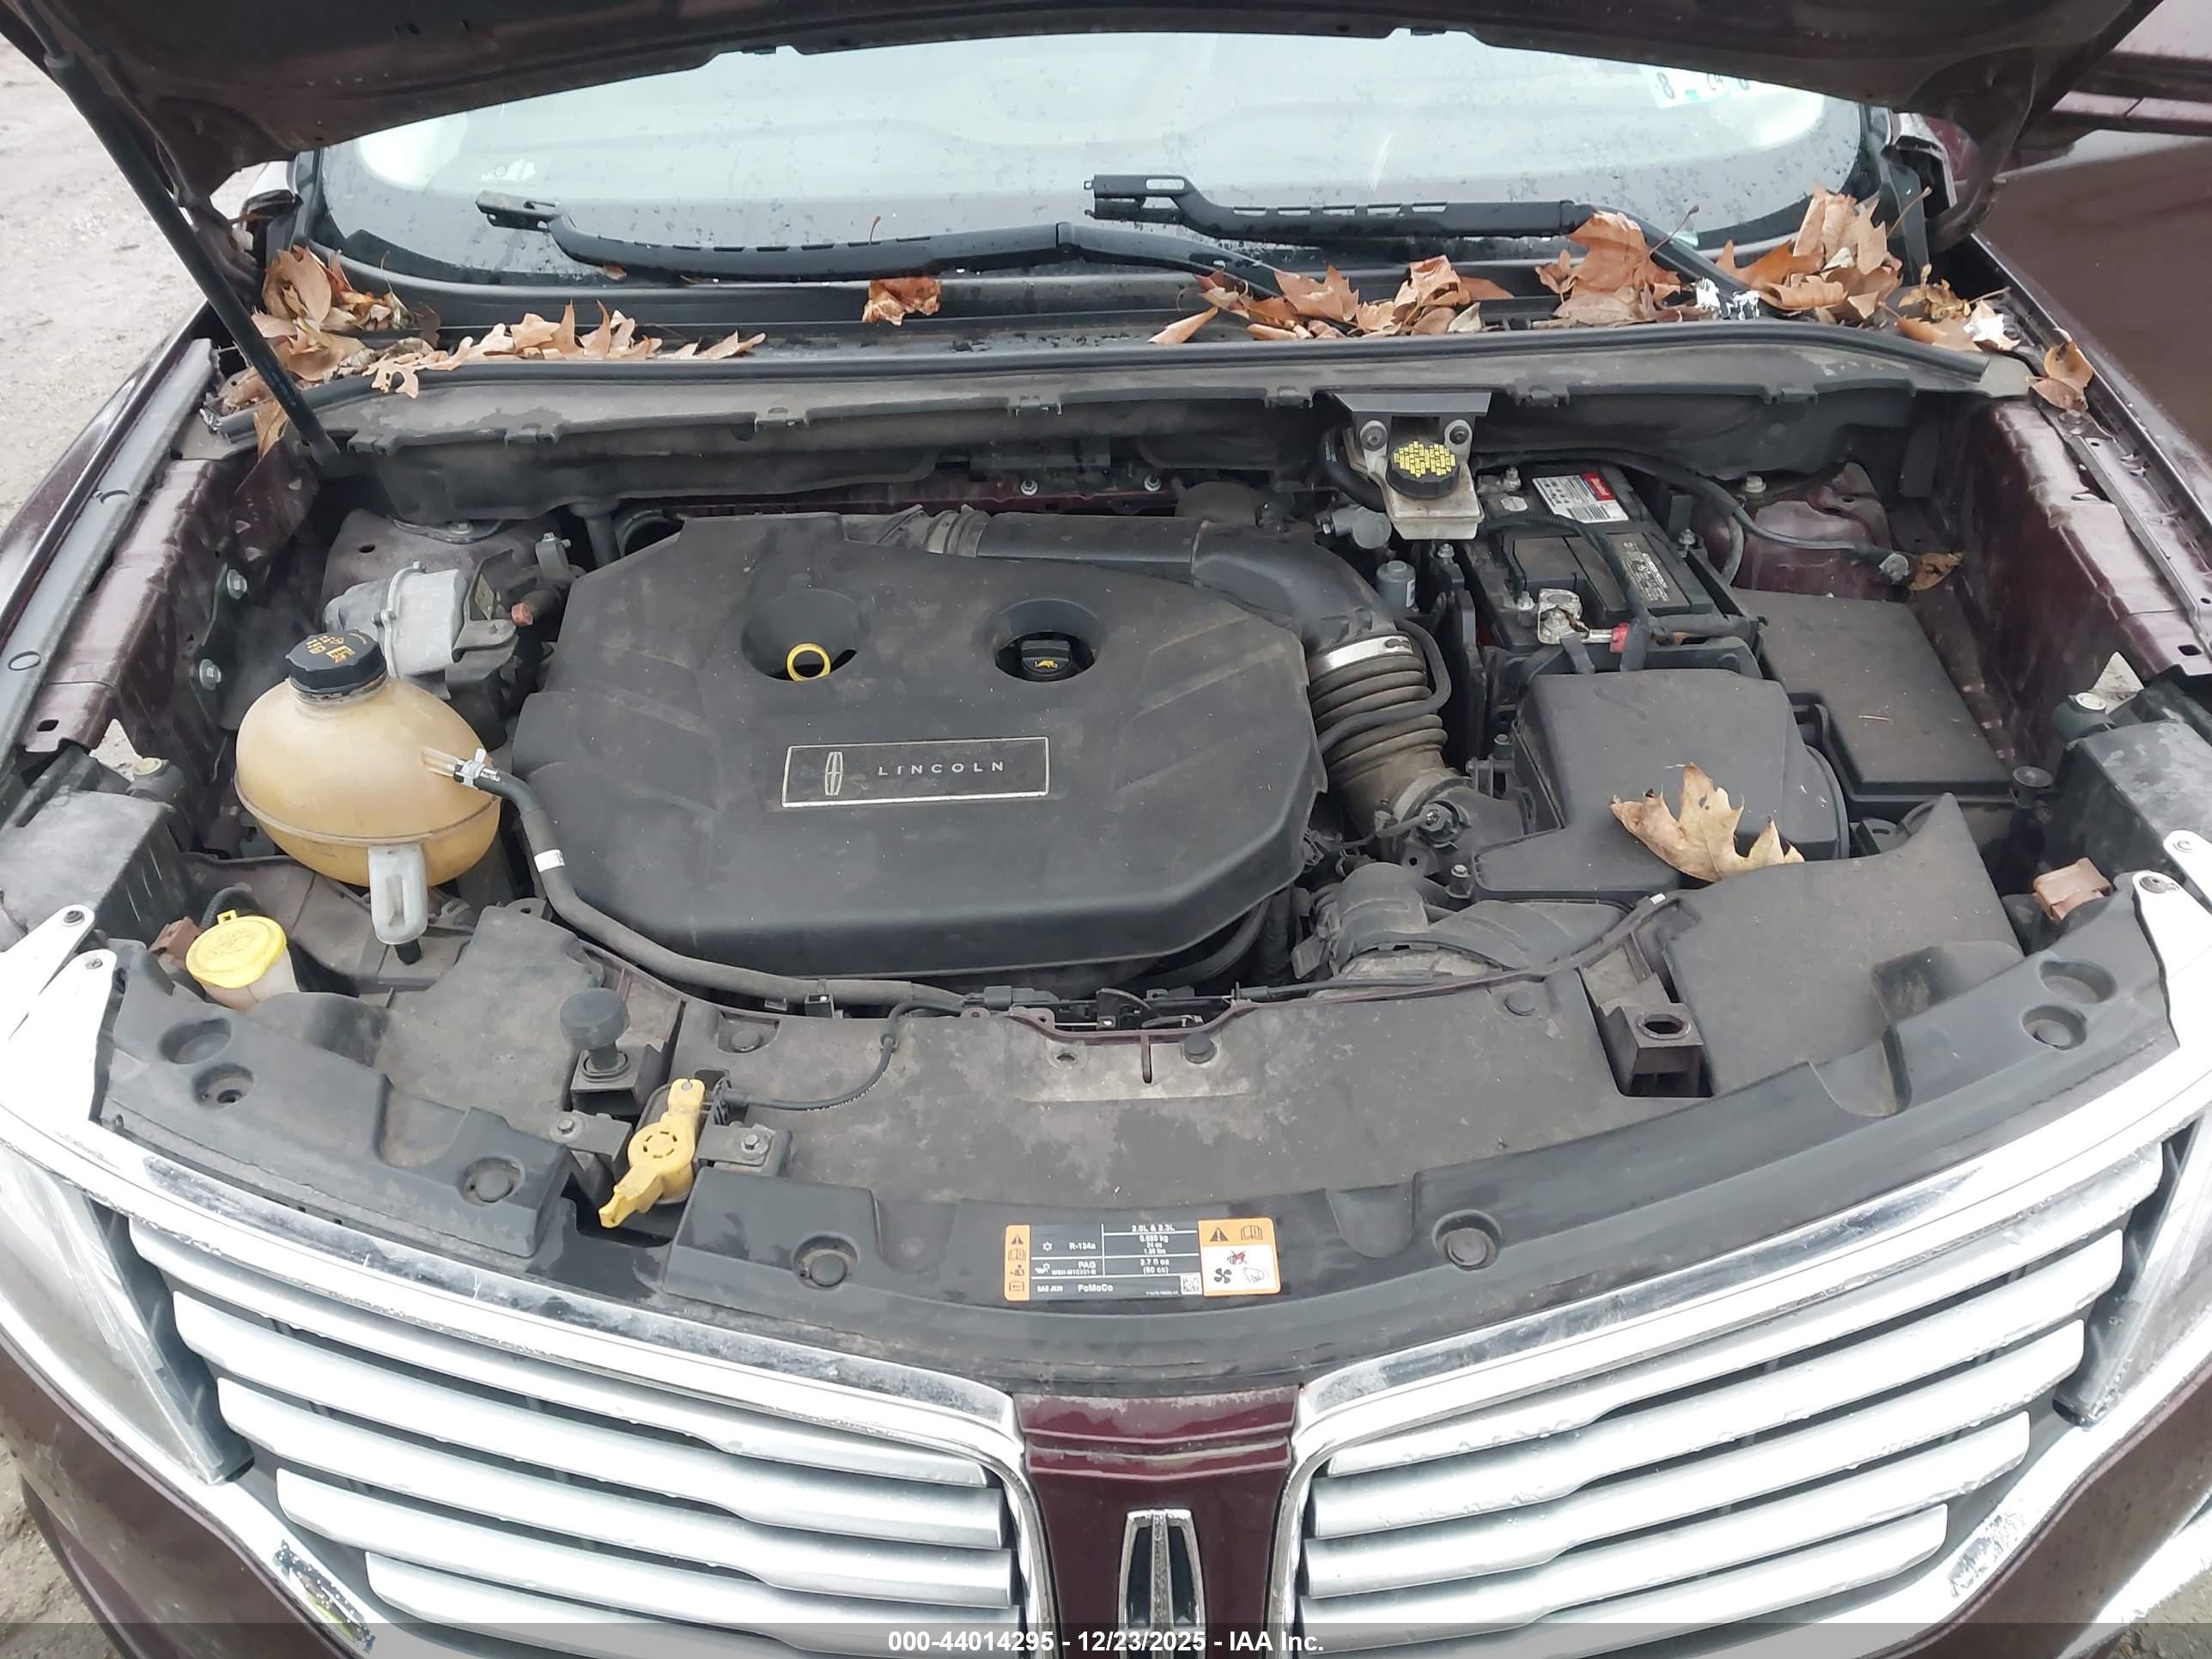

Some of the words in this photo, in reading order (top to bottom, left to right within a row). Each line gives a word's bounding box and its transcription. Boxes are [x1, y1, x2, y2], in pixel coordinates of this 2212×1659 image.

[878, 761, 1005, 776] LINCOLN
[1132, 1224, 1149, 1232] 2.0L
[1068, 1242, 1097, 1250] R-134a
[1078, 1283, 1114, 1292] FoMoCo
